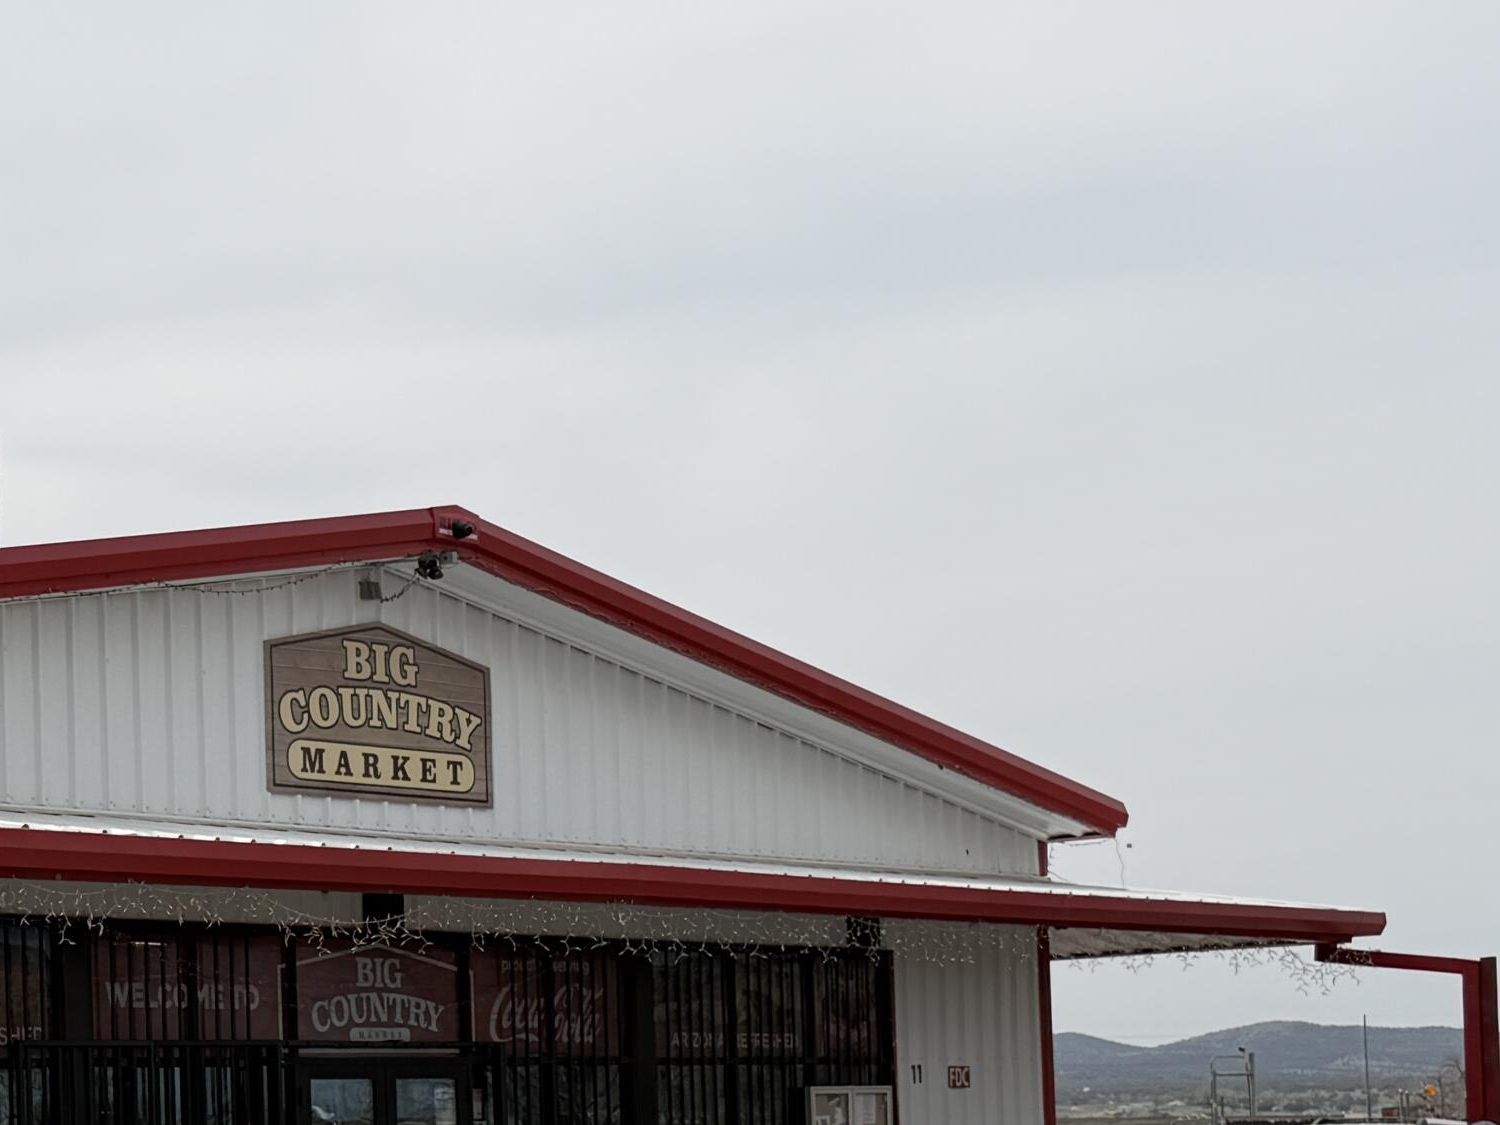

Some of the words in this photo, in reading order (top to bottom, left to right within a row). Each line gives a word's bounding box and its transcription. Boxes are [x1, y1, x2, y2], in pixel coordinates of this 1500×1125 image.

[343, 640, 419, 687] BIG
[279, 686, 482, 751] COUNTRY
[300, 747, 463, 786] MARKET
[355, 957, 404, 988] BIG
[233, 983, 260, 1011] TO
[311, 992, 445, 1032] COUNTRY
[911, 1064, 923, 1084] 11
[950, 1067, 969, 1087] FDC
